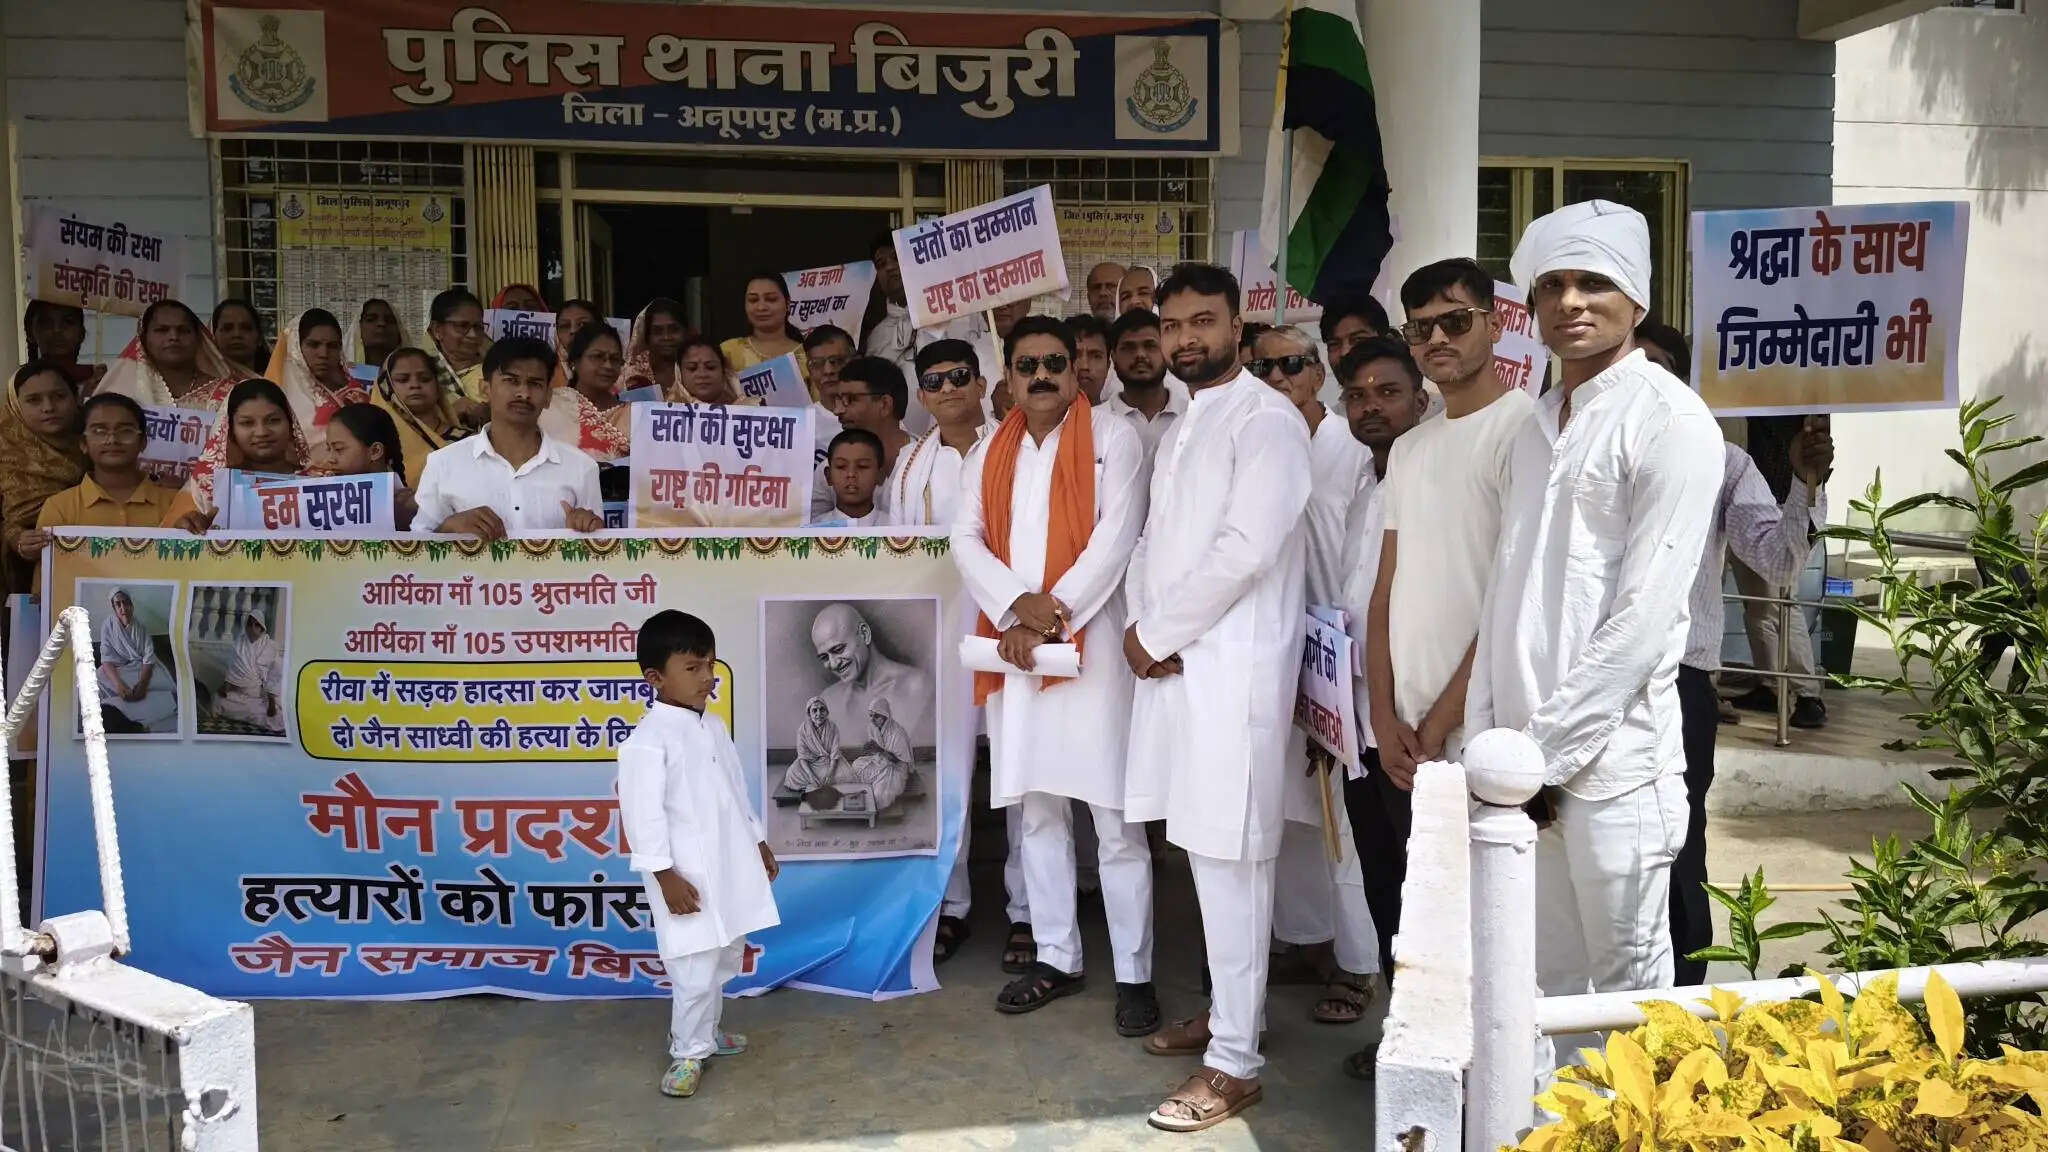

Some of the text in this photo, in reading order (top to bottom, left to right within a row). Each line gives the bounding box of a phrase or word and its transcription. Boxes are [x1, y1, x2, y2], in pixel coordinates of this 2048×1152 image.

[382, 7, 625, 104] पुलिस
[643, 33, 836, 93] थाना
[850, 21, 1081, 119] बिजुरी
[561, 92, 646, 126] जिला
[678, 105, 796, 140] अनूपपुर
[804, 104, 901, 137] (म.प्र.)
[60, 213, 162, 262] संयम की रक्षा
[909, 197, 1038, 264] संतों का सम्मान
[1728, 210, 1931, 286] श्रद्धा के साथ
[54, 258, 169, 306] संस्कृति की रक्षा
[923, 281, 959, 314] राष्ट्र
[957, 272, 982, 303] का
[983, 250, 1046, 297] सम्मान
[799, 297, 832, 322] सुरक्षा
[832, 295, 850, 310] का
[1717, 298, 1932, 370] जिम्मेदारी भी
[180, 416, 202, 445] की
[651, 402, 796, 459] संतों की सुरक्षा
[258, 487, 300, 529] हम
[649, 462, 791, 509] राष्ट्र की गरिमा
[362, 574, 656, 614] आर्यिका माँ 105 श्रुतमति जी
[344, 621, 637, 654] आर्यिका माँ 105 उपशममति
[320, 672, 367, 702] रीवा
[372, 672, 392, 702] में
[395, 679, 458, 709] सड़क
[463, 679, 536, 706] हादसा
[541, 679, 580, 701] कर
[331, 718, 354, 748] दो
[361, 718, 400, 747] जैन
[401, 719, 474, 750] साध्वी
[480, 719, 512, 748] की
[519, 724, 570, 748] हत्या
[575, 717, 600, 749] के
[303, 773, 438, 853] मौन
[243, 866, 655, 929] हत्यारों को फांस
[231, 936, 347, 975] जैन
[360, 946, 555, 974] समाज
